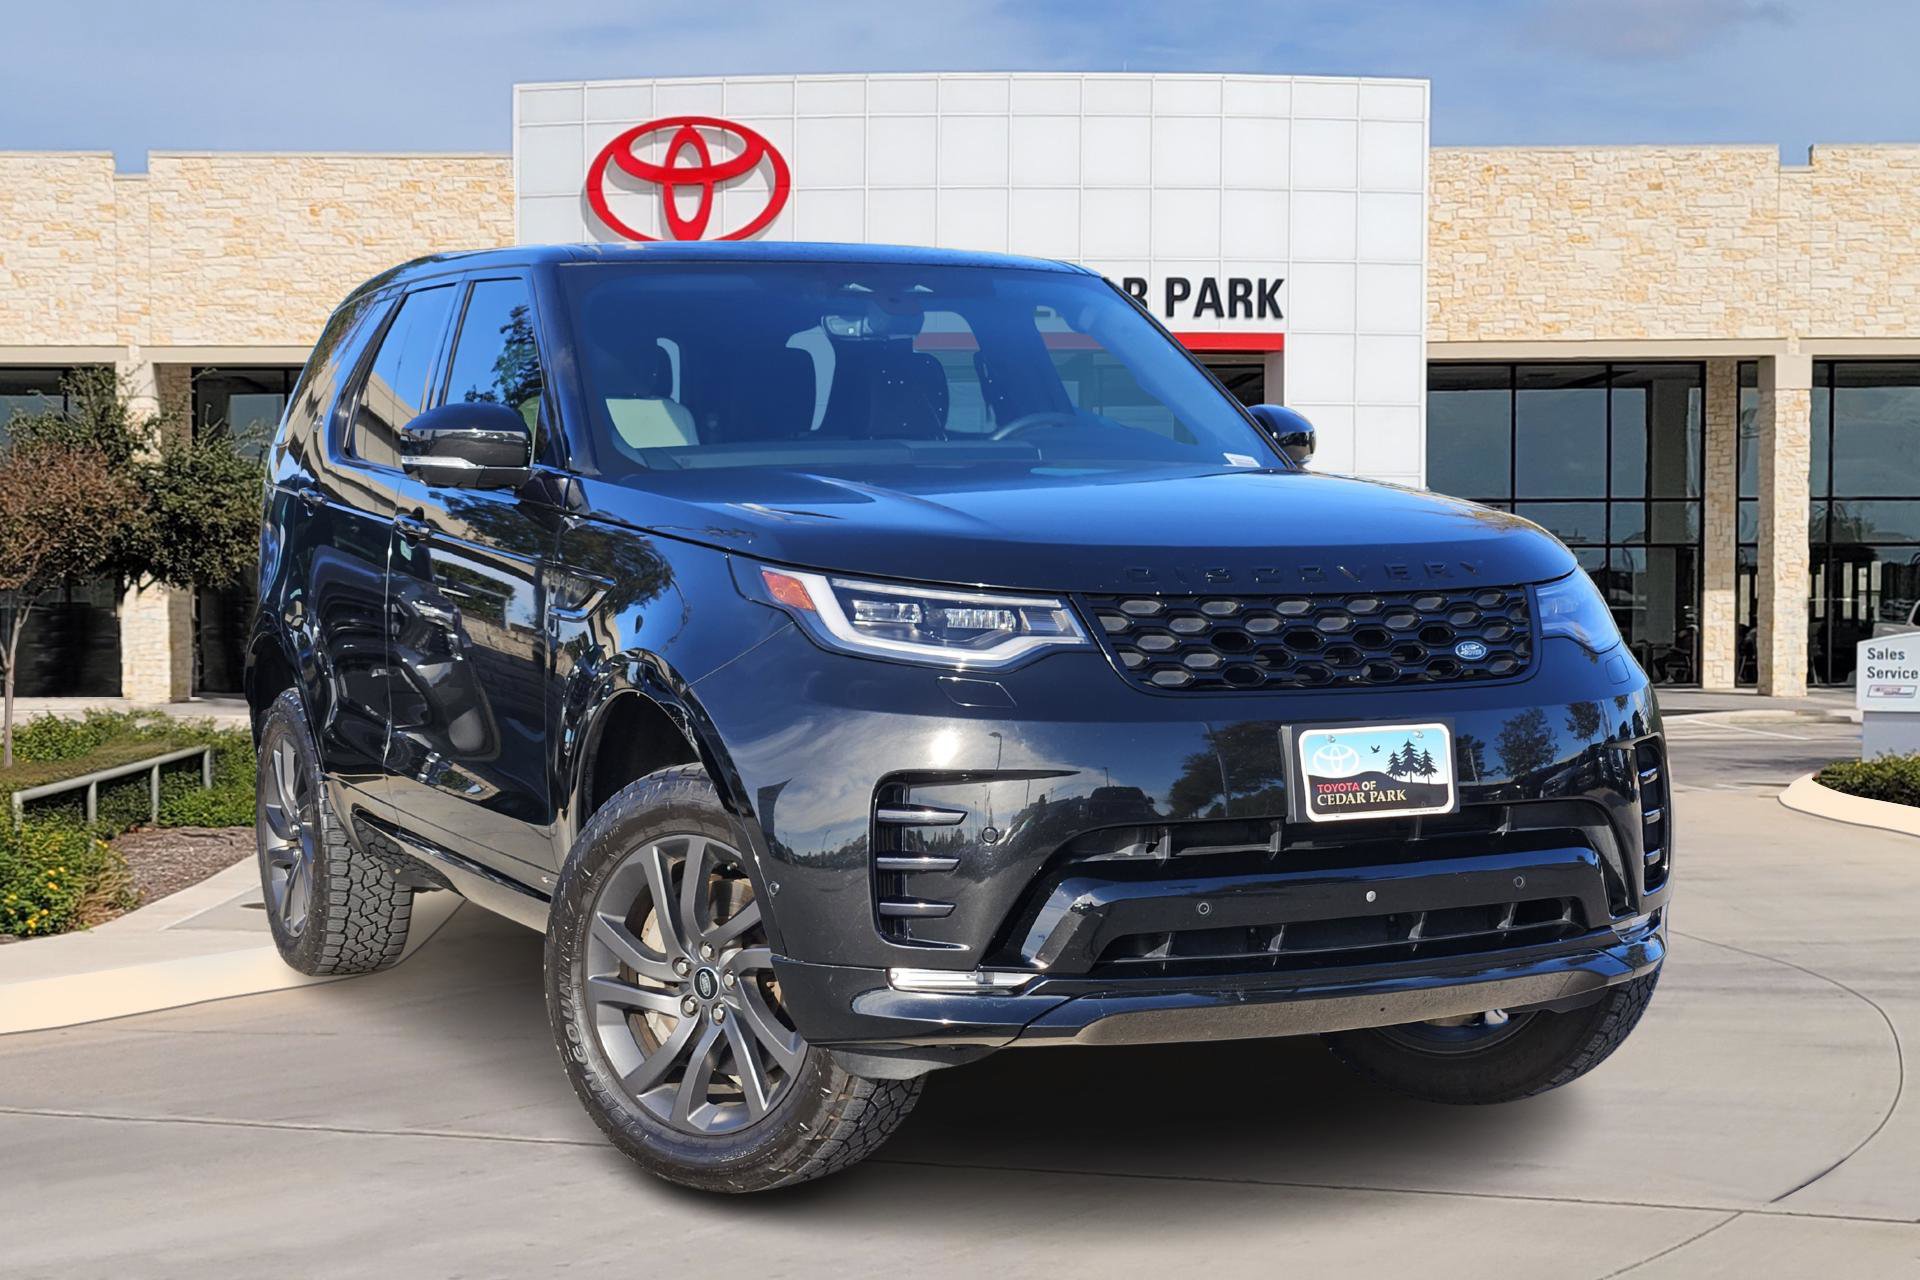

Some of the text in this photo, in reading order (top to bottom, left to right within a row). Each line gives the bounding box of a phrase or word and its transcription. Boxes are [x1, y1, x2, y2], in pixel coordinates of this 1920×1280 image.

[1165, 276, 1285, 319] PARK
[1867, 647, 1906, 660] Sales
[1867, 666, 1919, 679] Service
[1316, 780, 1377, 794] TOYOTA OF
[1316, 789, 1407, 806] CEDAR PARK
